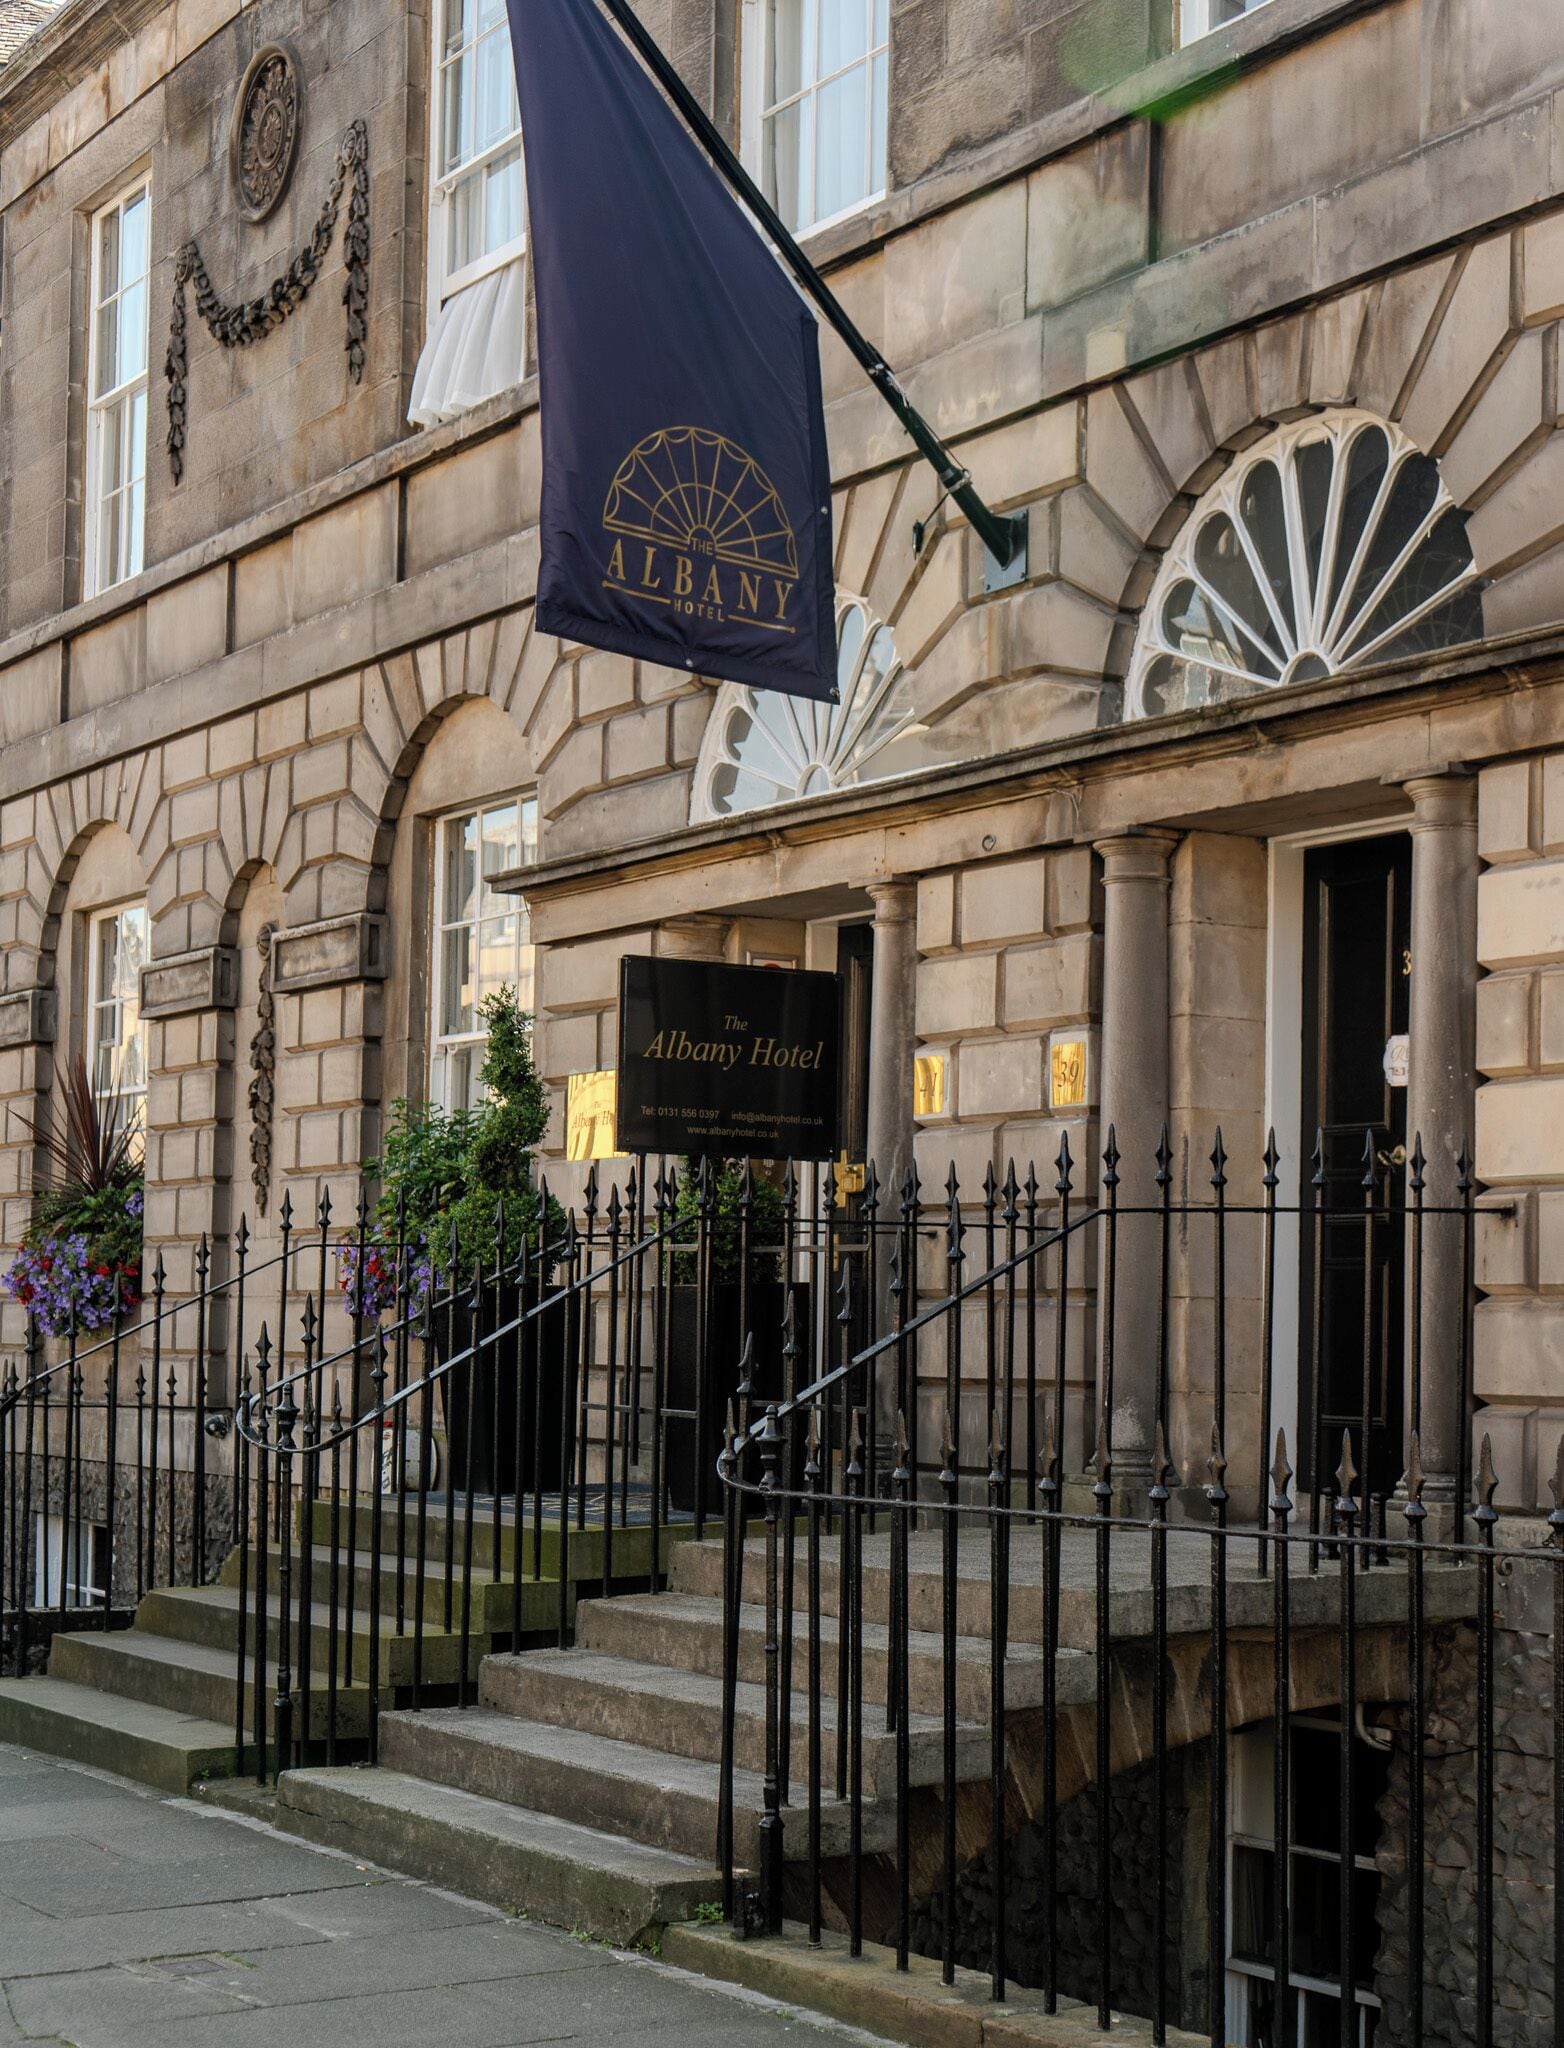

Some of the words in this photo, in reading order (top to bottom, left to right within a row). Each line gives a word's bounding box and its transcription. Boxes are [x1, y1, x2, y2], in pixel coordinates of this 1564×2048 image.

[691, 537, 714, 556] THE
[606, 538, 793, 620] ALBANY
[673, 599, 725, 622] HOTEL
[724, 1014, 749, 1031] The
[643, 1029, 742, 1071] Albany
[748, 1036, 825, 1070] Hotel
[1057, 1060, 1080, 1088] 39
[657, 1107, 679, 1117] 0131
[681, 1108, 698, 1119] 556
[698, 1109, 720, 1120] 0397
